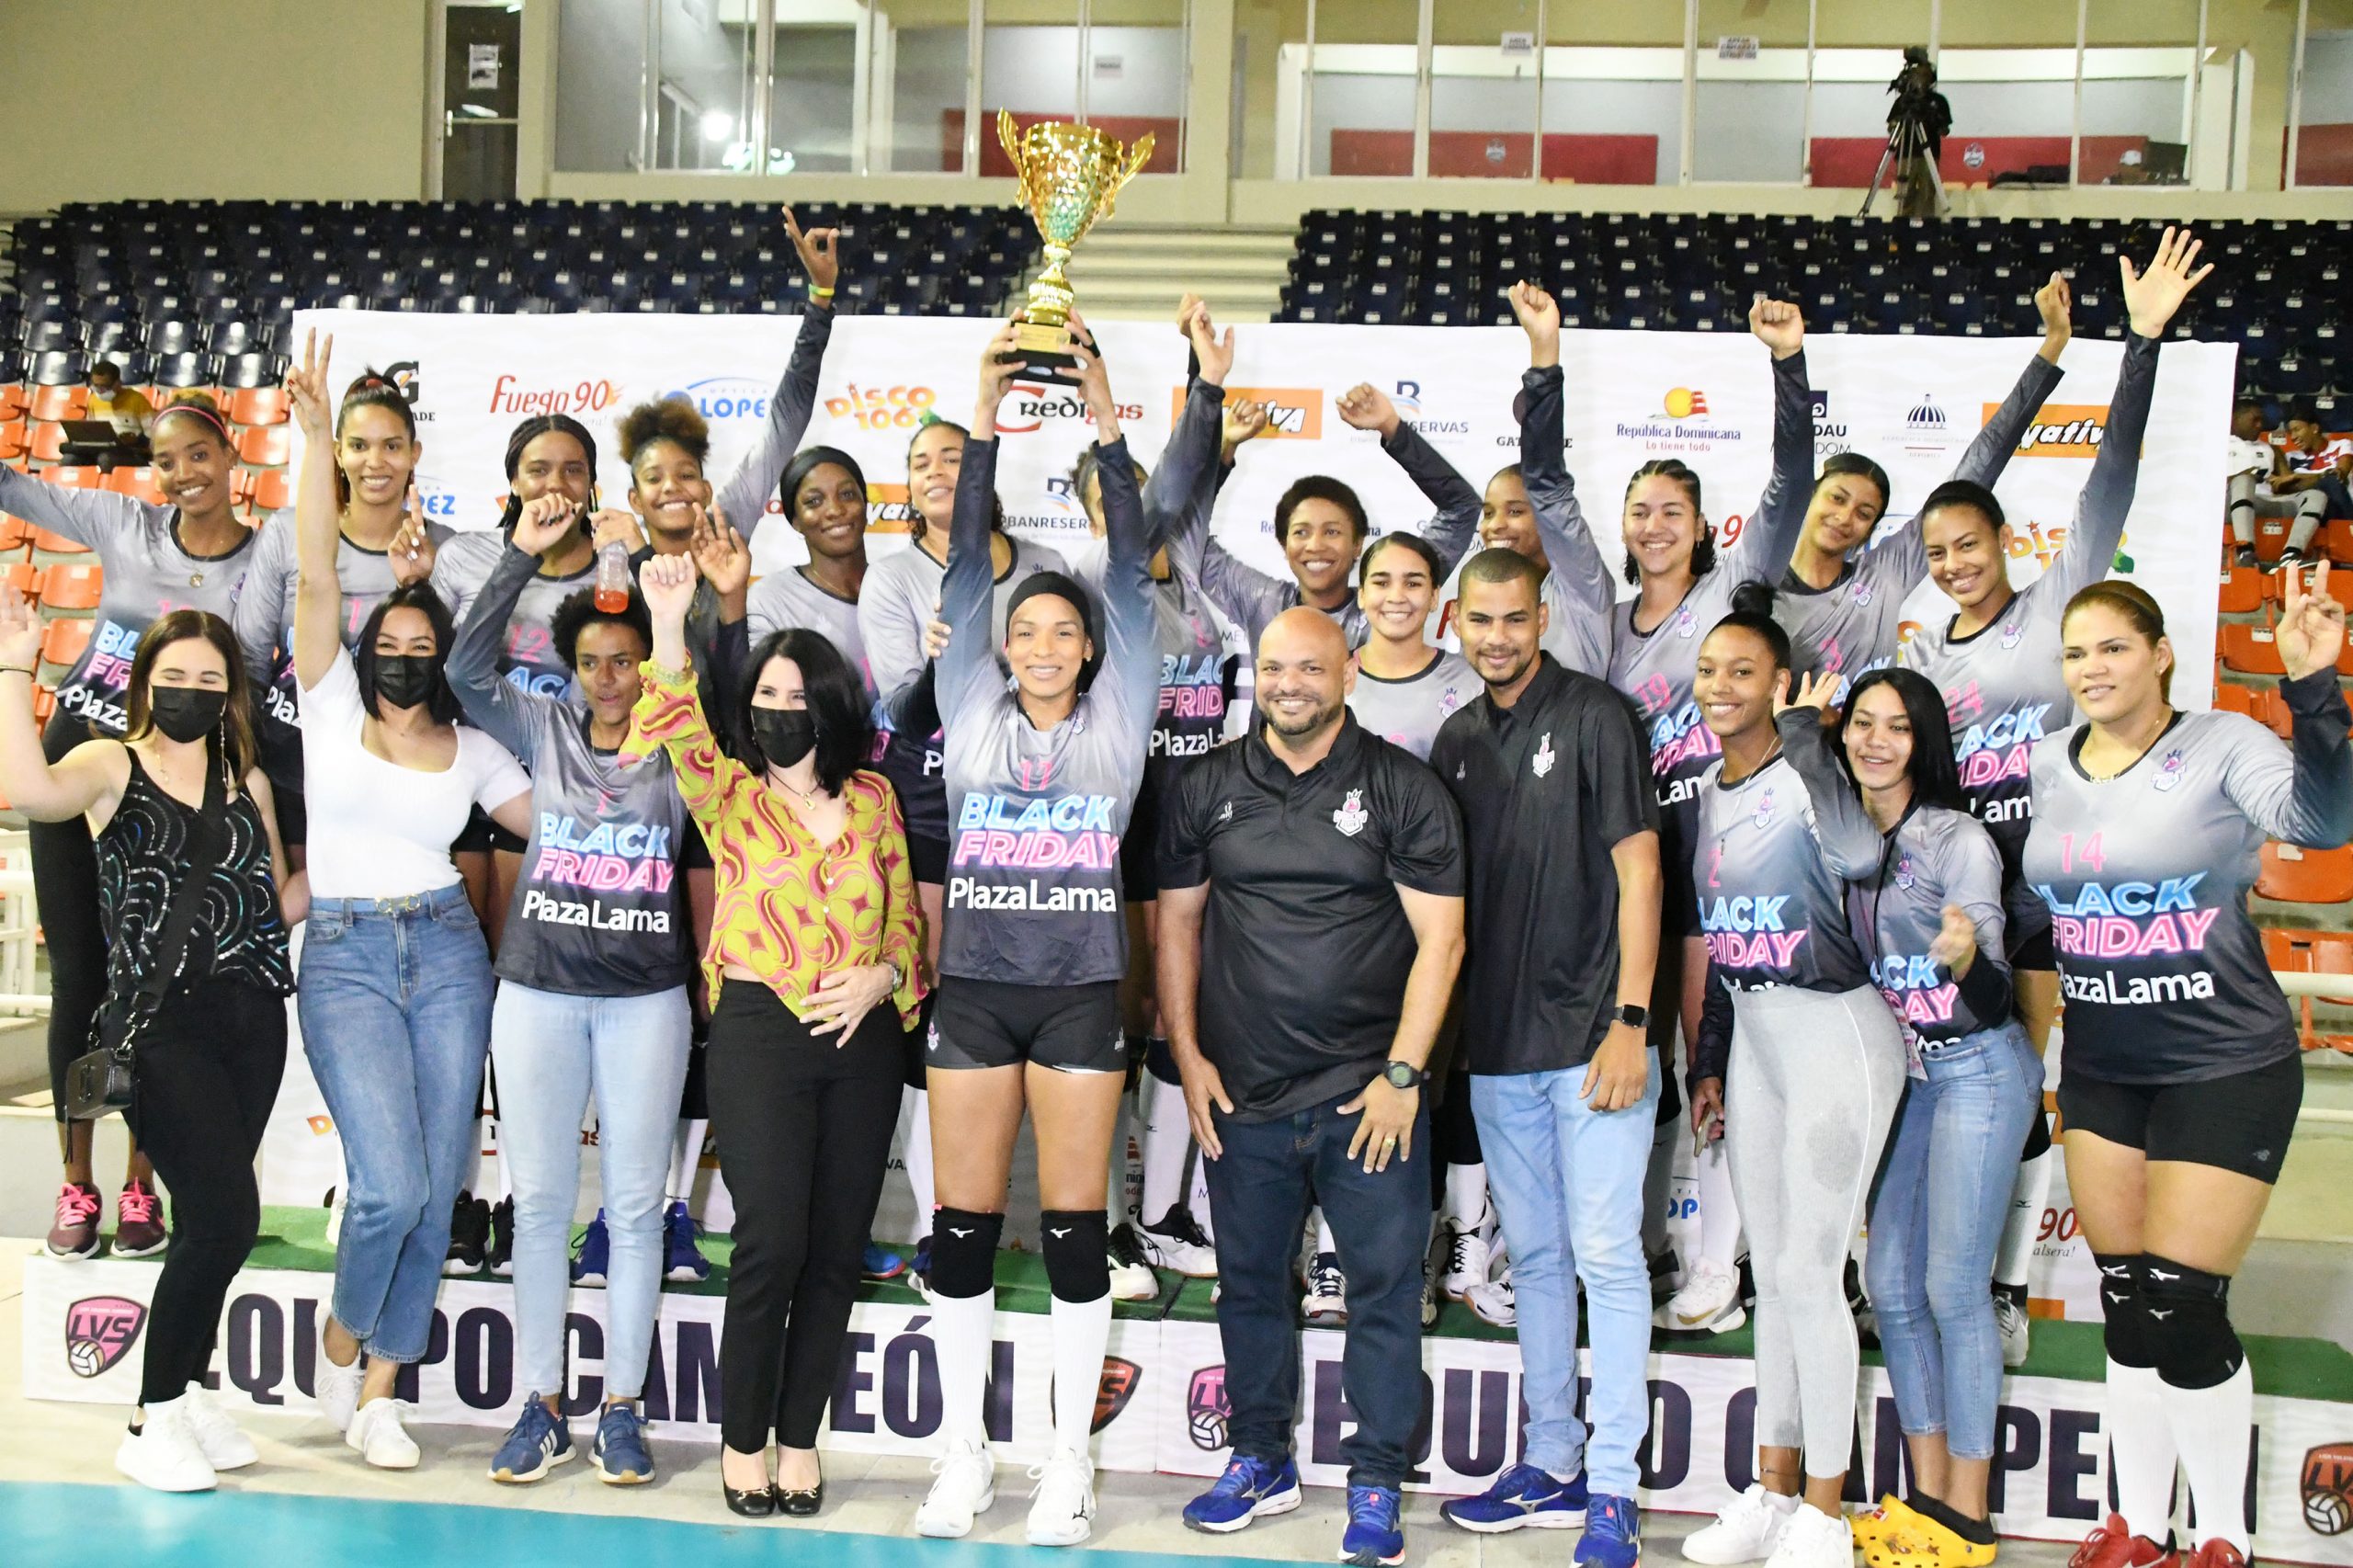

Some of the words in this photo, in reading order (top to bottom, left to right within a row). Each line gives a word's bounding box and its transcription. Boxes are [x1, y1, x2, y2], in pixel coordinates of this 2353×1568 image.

[490, 375, 570, 417] Fuego
[574, 379, 610, 413] 90
[699, 398, 766, 418] LOPE
[1617, 423, 1672, 439] República
[1675, 425, 1741, 440] Dominicana
[1645, 440, 1657, 450] Lo
[1661, 440, 1685, 450] tiene
[1689, 441, 1711, 451] todo
[957, 792, 1118, 832] BLACK
[539, 811, 671, 858] BLACK
[952, 829, 1120, 869] FRIDAY
[2058, 830, 2108, 873] 14
[530, 846, 676, 894] FRIDAY
[2029, 870, 2209, 916] LACK
[2036, 1208, 2077, 1242] 90
[2032, 1244, 2076, 1257] alsera!
[69, 1314, 133, 1343] LVS
